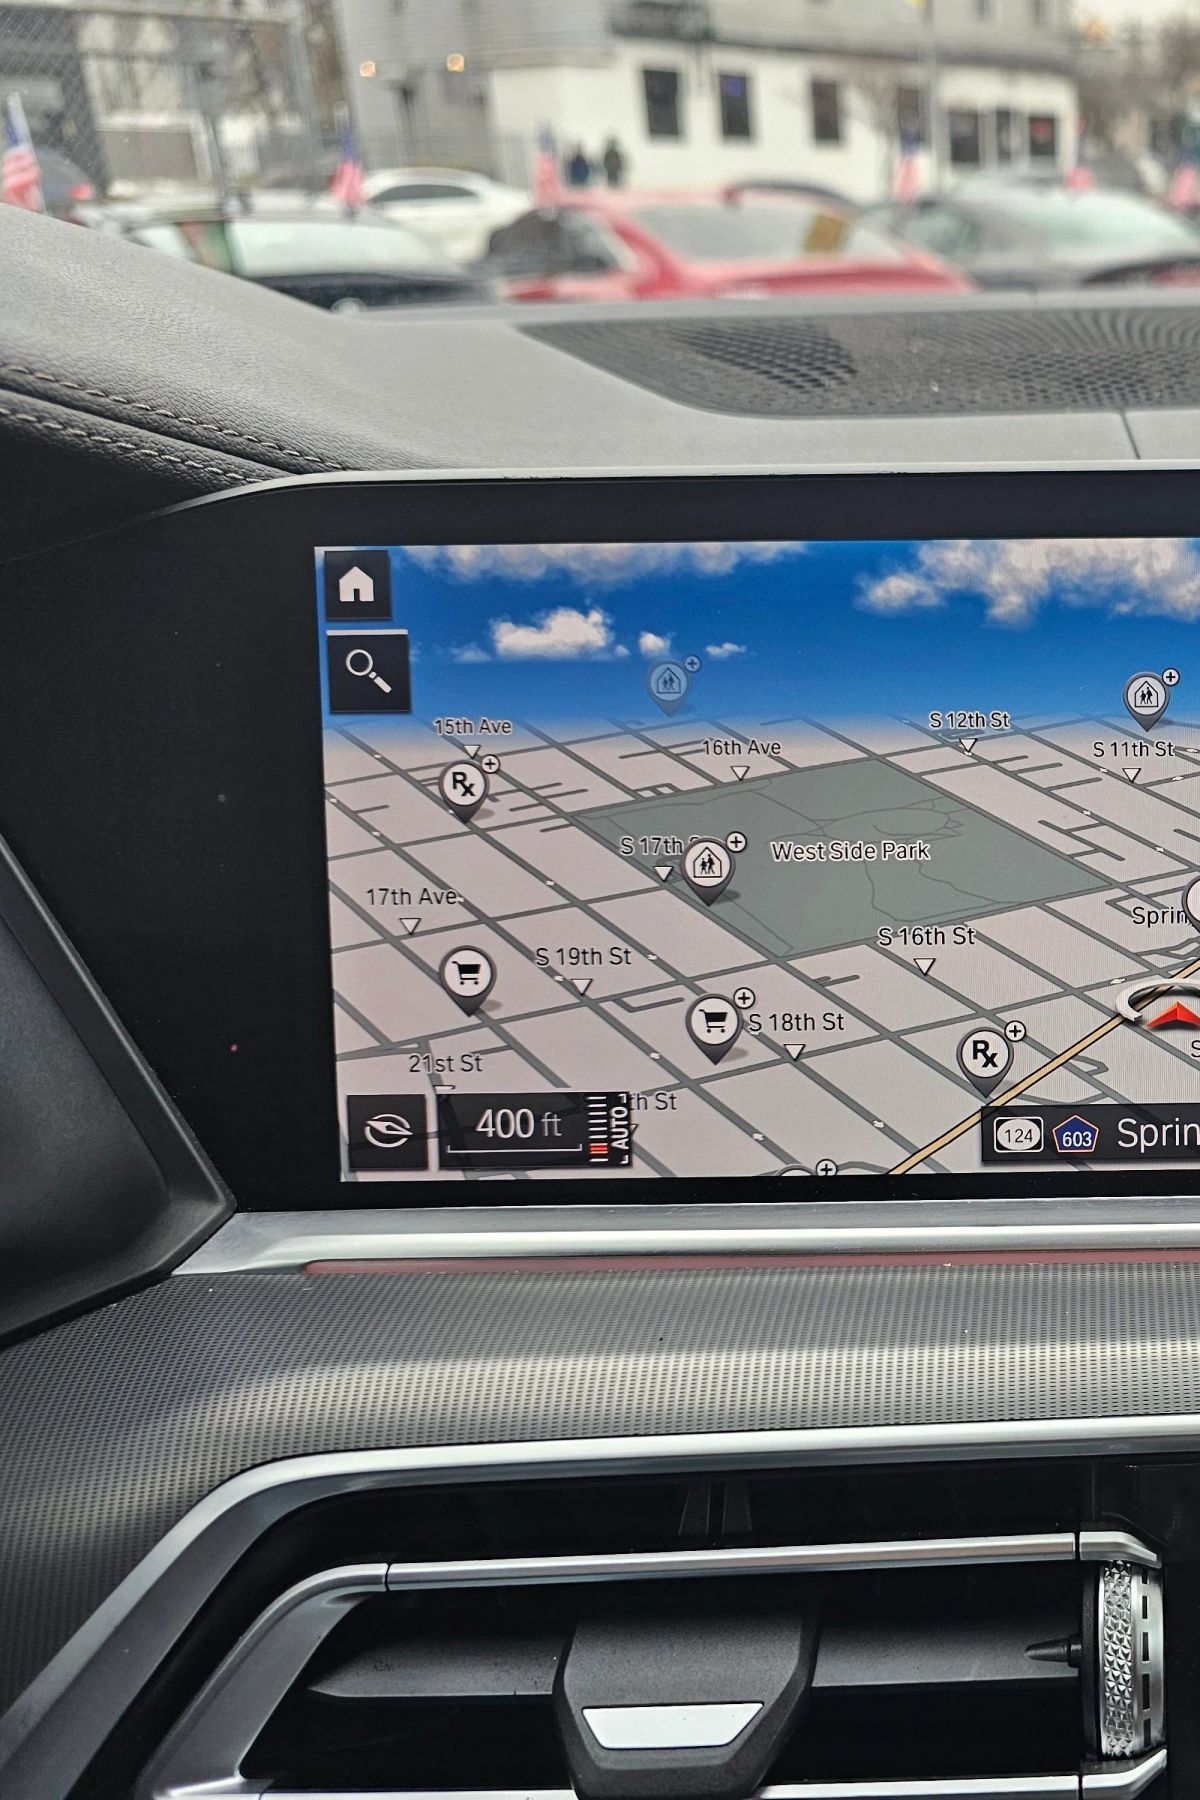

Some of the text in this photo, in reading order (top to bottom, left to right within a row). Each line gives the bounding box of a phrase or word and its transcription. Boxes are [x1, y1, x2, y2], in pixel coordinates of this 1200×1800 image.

[434, 718, 512, 735] 15th Ave
[929, 712, 1010, 729] S 12th St
[702, 739, 781, 755] 16th Ave
[1093, 741, 1174, 758] S 11th St
[621, 837, 634, 855] S
[640, 837, 683, 854] 17th
[771, 841, 931, 861] West Side Park
[366, 888, 457, 905] 17th Ave
[879, 927, 975, 946] S 16th St
[536, 947, 632, 965] S 19th St
[749, 1013, 845, 1032] S 18th St
[409, 1055, 483, 1073] 21st St
[655, 1092, 677, 1110] St
[476, 1109, 561, 1138] 400 ft
[610, 1106, 629, 1150] AUTO
[1003, 1127, 1034, 1144] 124
[1062, 1130, 1093, 1148] 603
